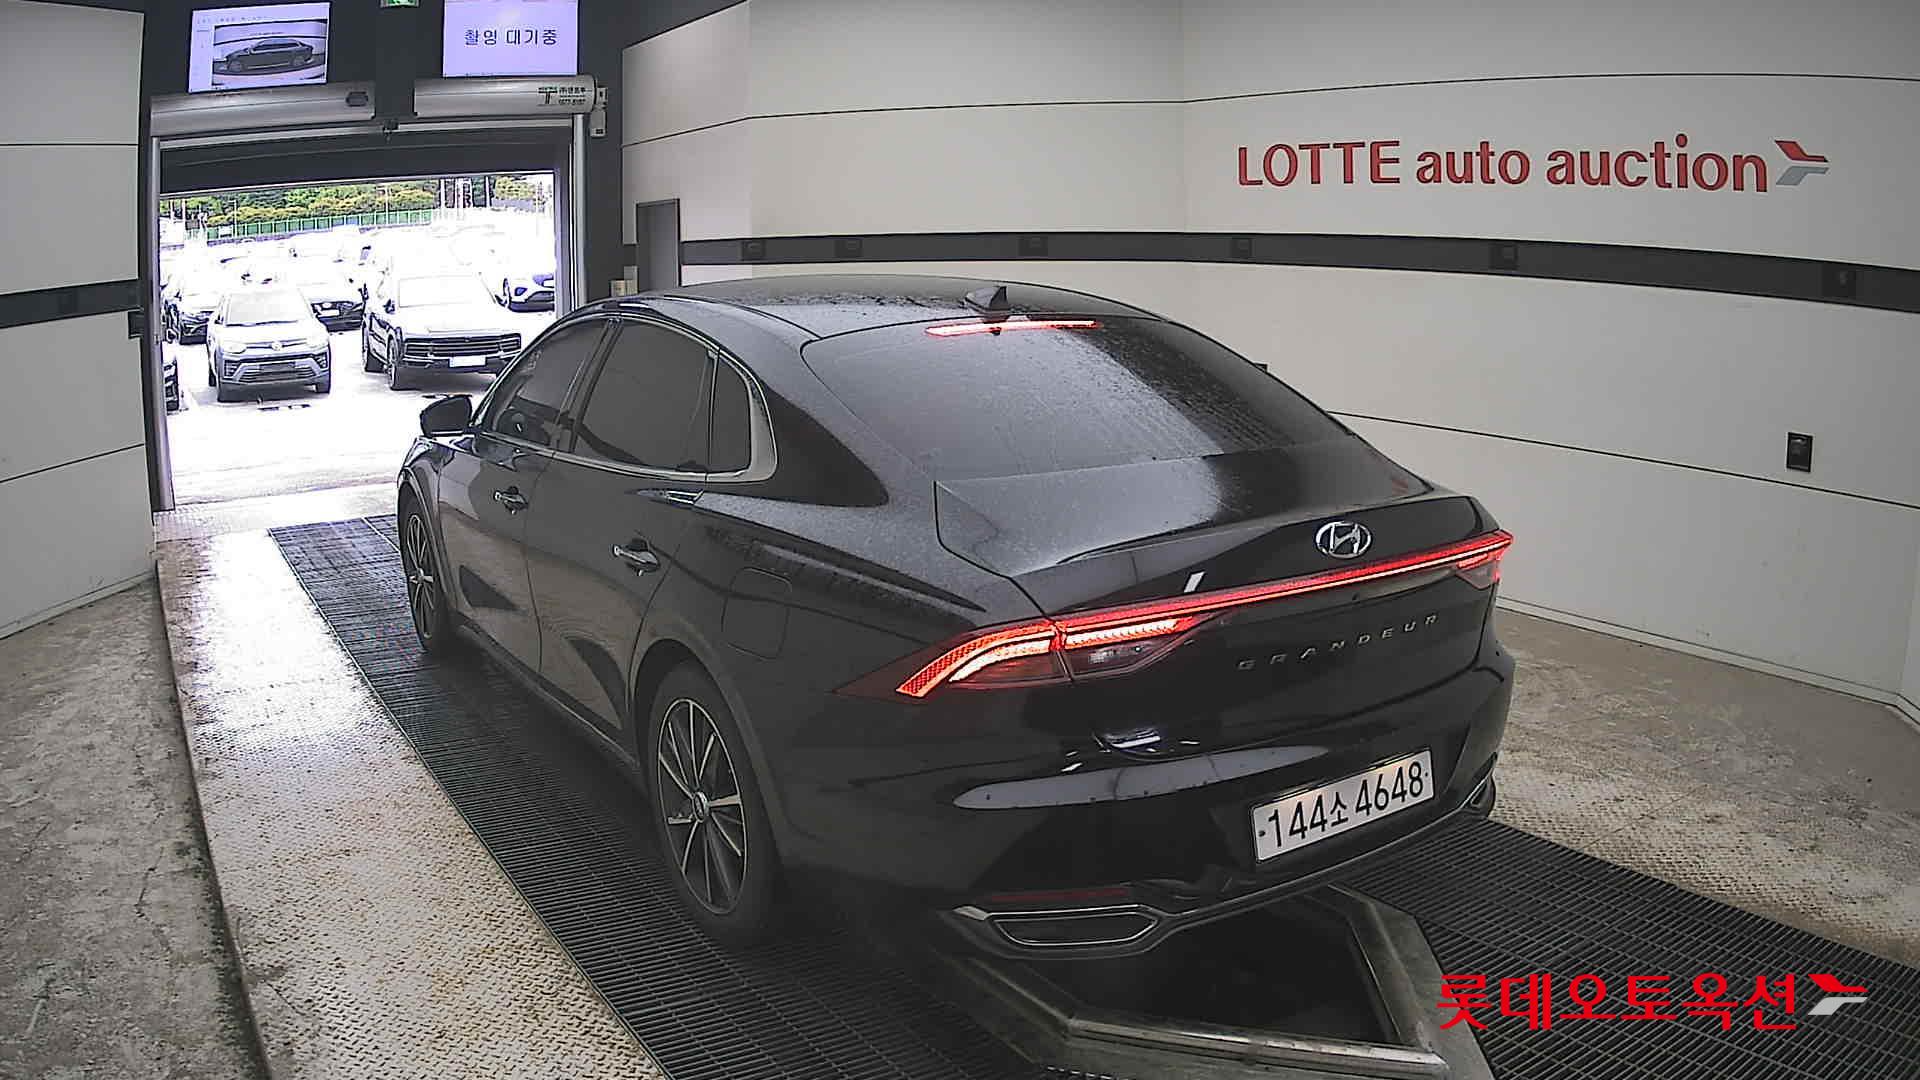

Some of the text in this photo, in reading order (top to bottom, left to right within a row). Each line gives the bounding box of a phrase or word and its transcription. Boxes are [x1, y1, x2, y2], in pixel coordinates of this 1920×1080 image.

[506, 29, 557, 46] 대기중
[1237, 133, 1769, 194] LOTTE auto auction
[1237, 612, 1440, 671] GRANDEUR
